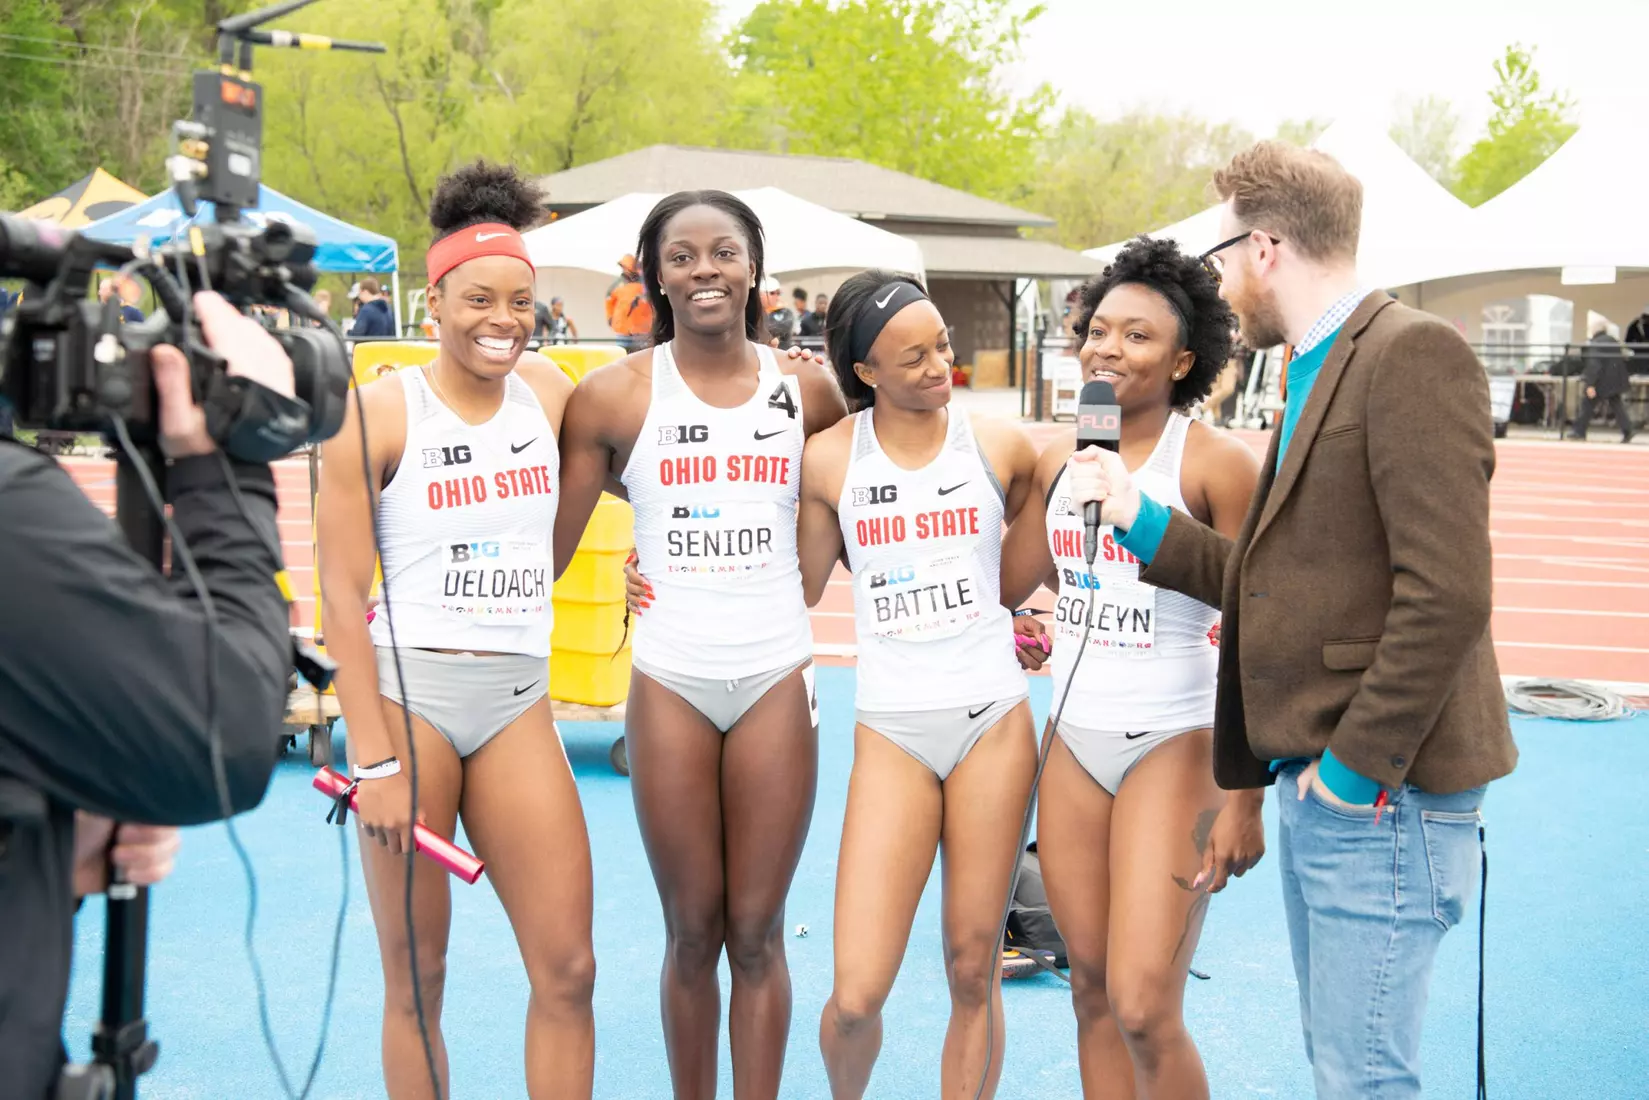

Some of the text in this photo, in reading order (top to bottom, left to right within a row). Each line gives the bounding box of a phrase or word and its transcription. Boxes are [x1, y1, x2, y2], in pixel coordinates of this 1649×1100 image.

[768, 381, 798, 420] 4
[1079, 414, 1118, 430] FLO
[660, 455, 790, 486] OHIO STATE
[427, 465, 552, 510] OHIO STATE
[667, 527, 773, 557] SENIOR
[856, 507, 980, 547] OHIO STATE
[1053, 529, 1086, 558] OHI
[444, 568, 545, 598] DELOACH
[874, 578, 973, 622] BATTLE
